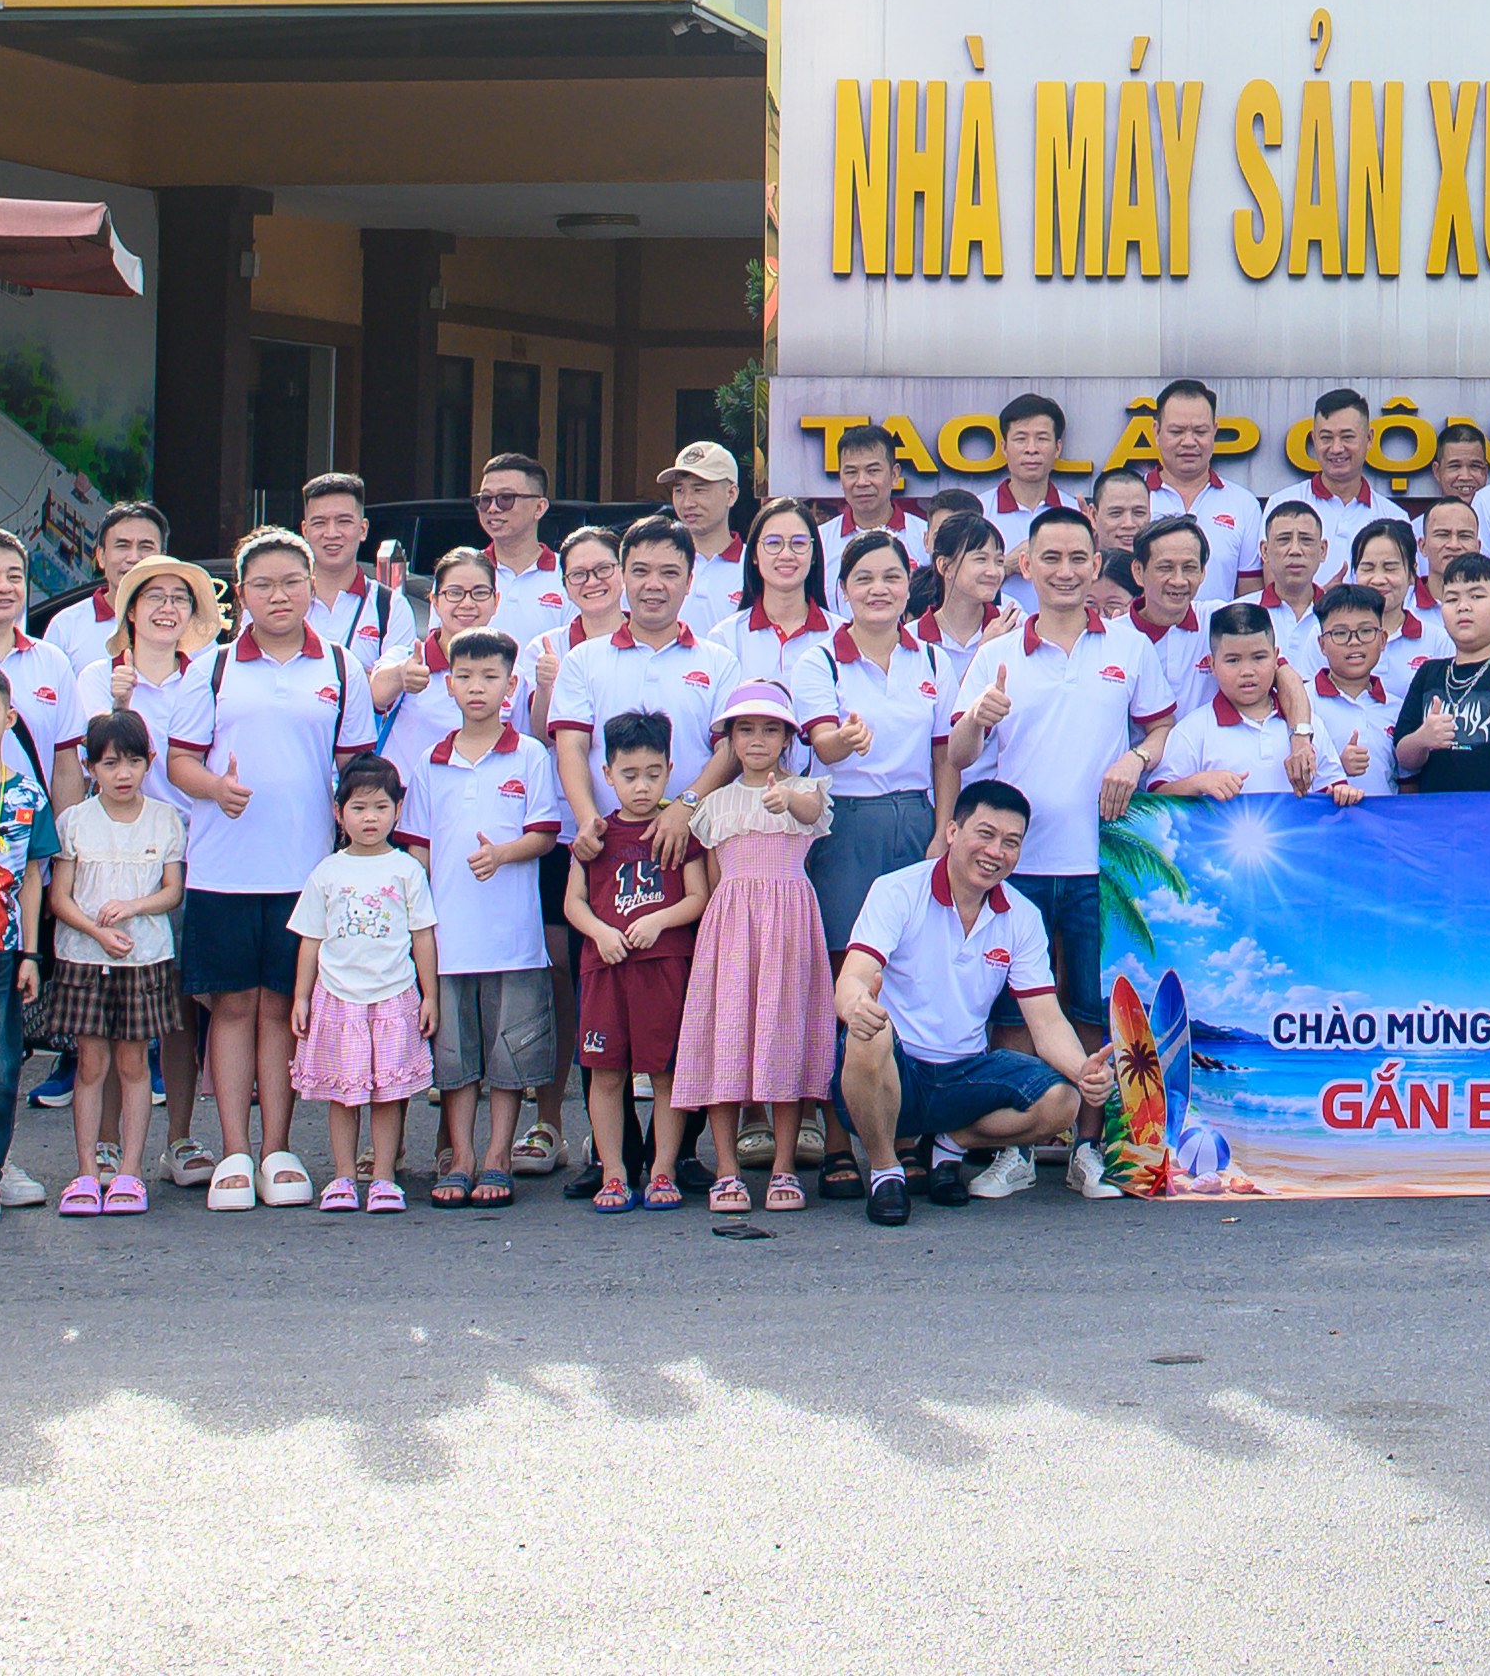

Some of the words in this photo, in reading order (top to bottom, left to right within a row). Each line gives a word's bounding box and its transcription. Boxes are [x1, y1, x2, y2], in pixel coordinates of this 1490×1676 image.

[833, 36, 1004, 277] NHÀ
[1034, 36, 1203, 277] MÁY
[1233, 9, 1404, 279] SẢN
[1273, 1005, 1377, 1045] CHÀO
[1322, 1063, 1449, 1129] GẮN
